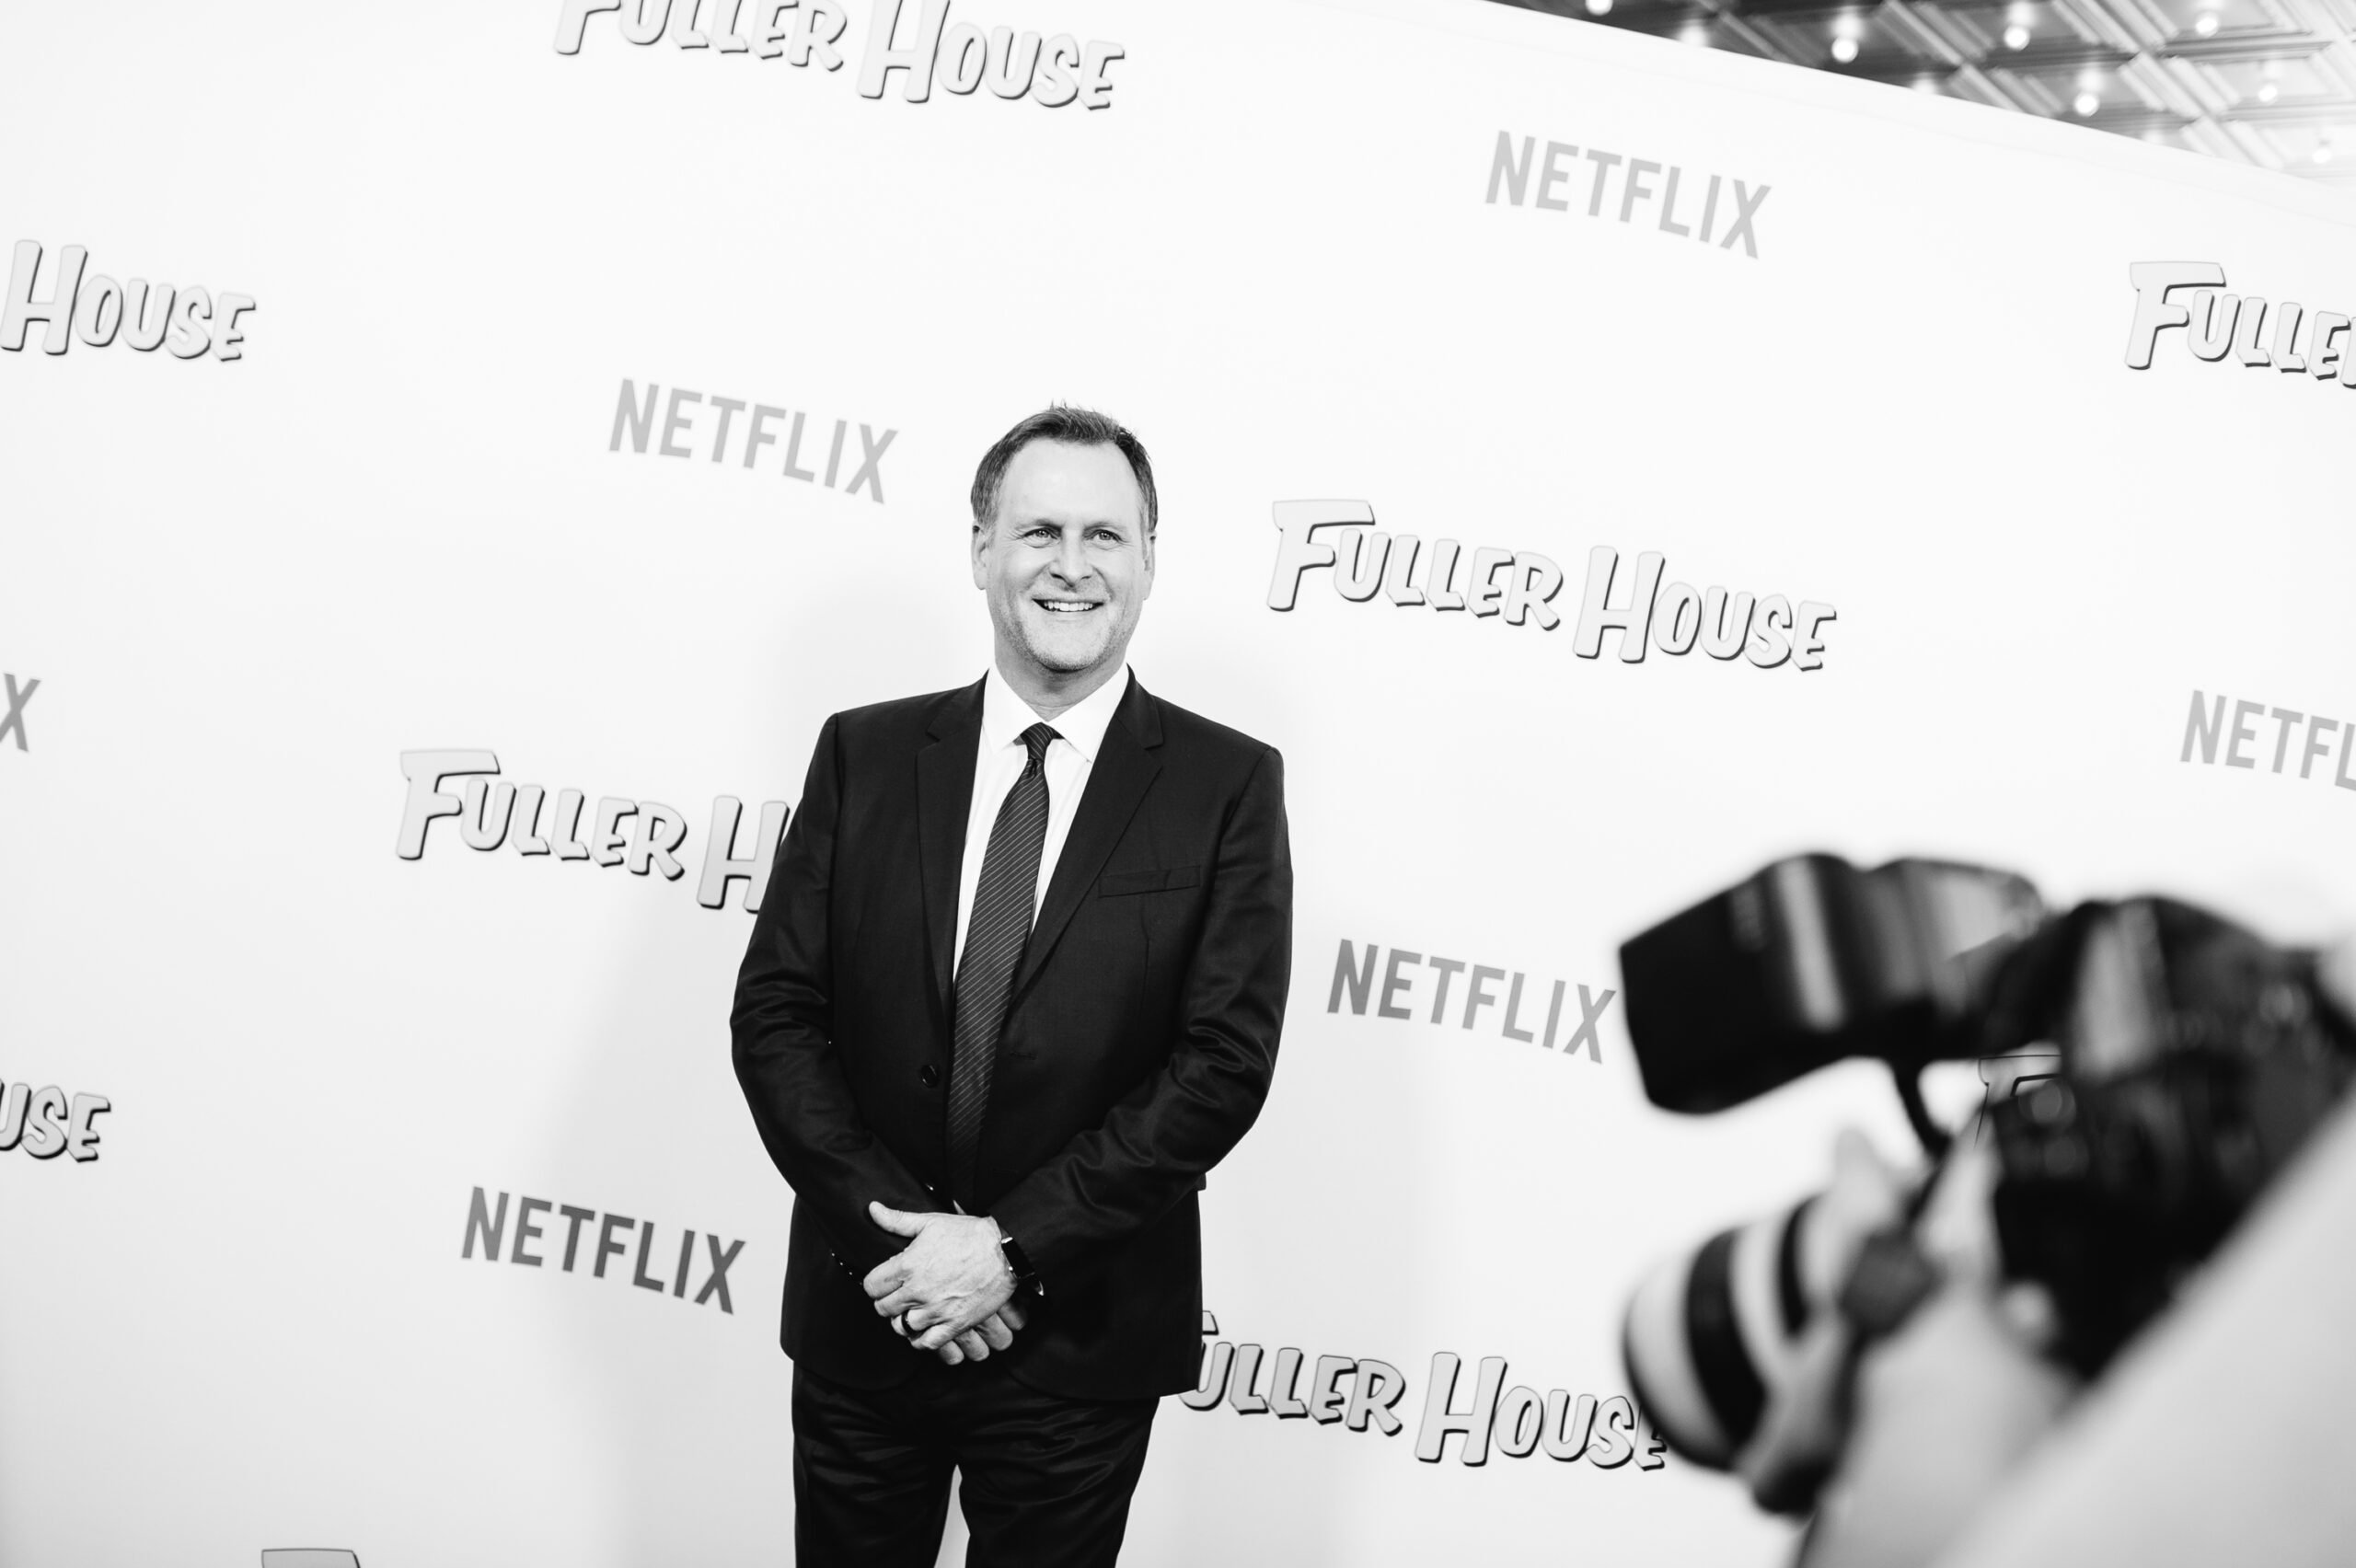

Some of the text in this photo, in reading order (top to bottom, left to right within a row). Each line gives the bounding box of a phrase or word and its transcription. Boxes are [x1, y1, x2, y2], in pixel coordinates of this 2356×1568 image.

[858, 0, 1126, 111] HOUSE
[1485, 130, 1772, 259] NETFLIX
[0, 239, 257, 363] HOUSE
[2124, 260, 2356, 390] FULLE
[609, 378, 897, 503] NETFLIX
[1266, 499, 1837, 673] FULLER HOUSE
[396, 749, 688, 882] FULLER
[1327, 939, 1617, 1064] NETFLIX
[461, 1186, 746, 1315] NETFLIX
[1179, 1309, 1406, 1437] ULLER
